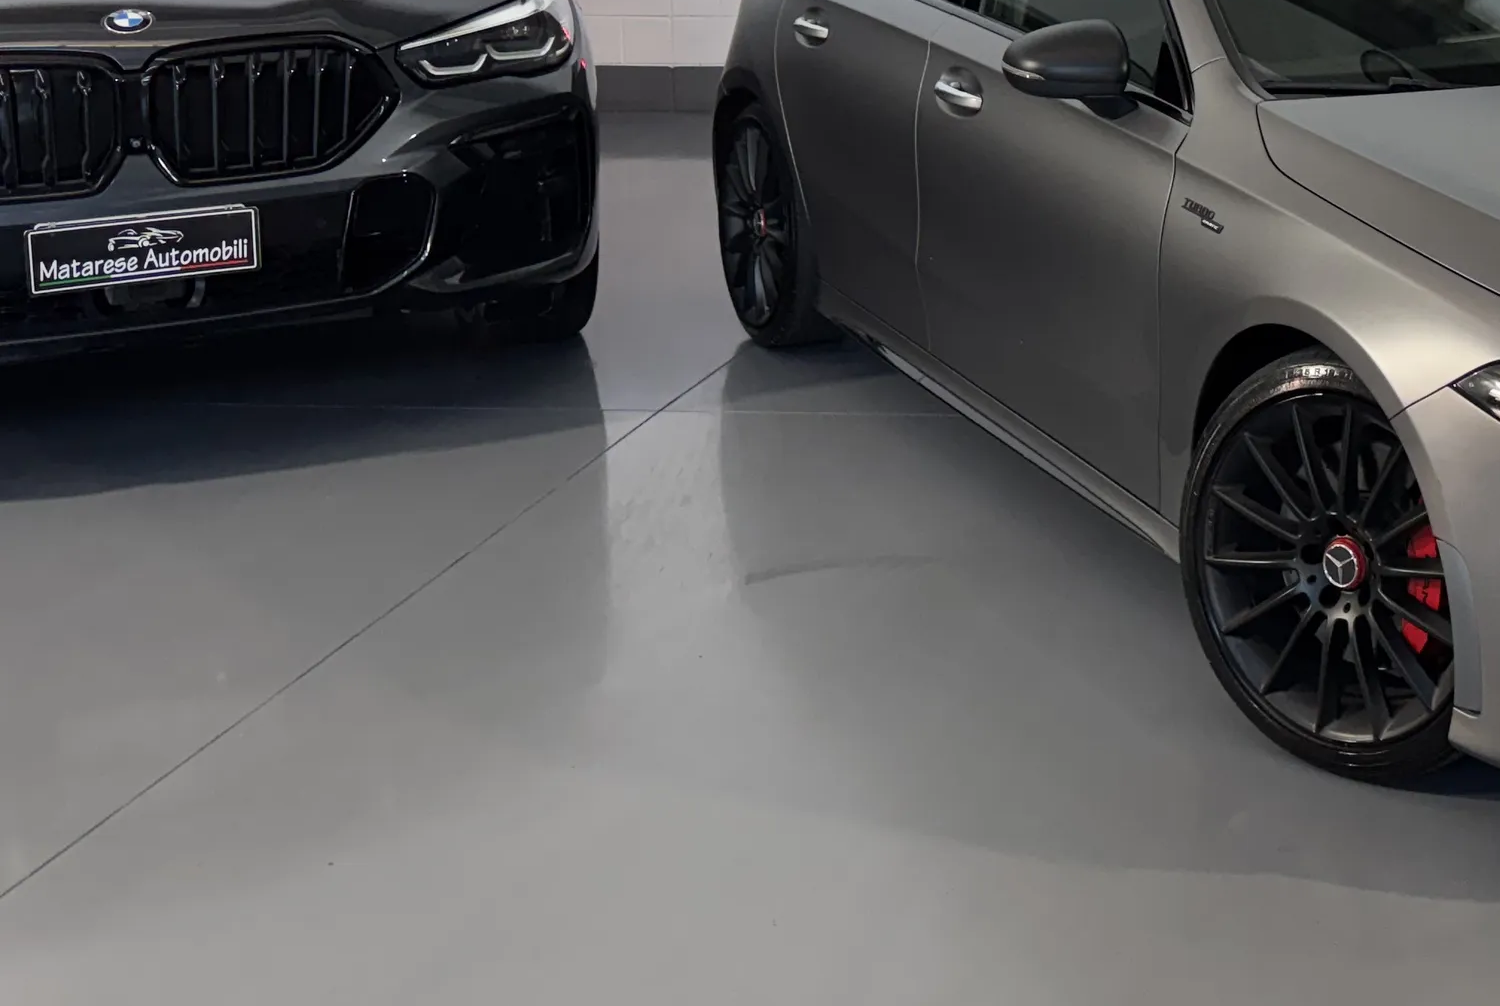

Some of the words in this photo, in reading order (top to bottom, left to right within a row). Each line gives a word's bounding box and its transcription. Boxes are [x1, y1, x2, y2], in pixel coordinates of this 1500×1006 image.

[1181, 197, 1216, 220] TURBO
[39, 255, 139, 282] Matarese
[143, 238, 249, 270] Automobili
